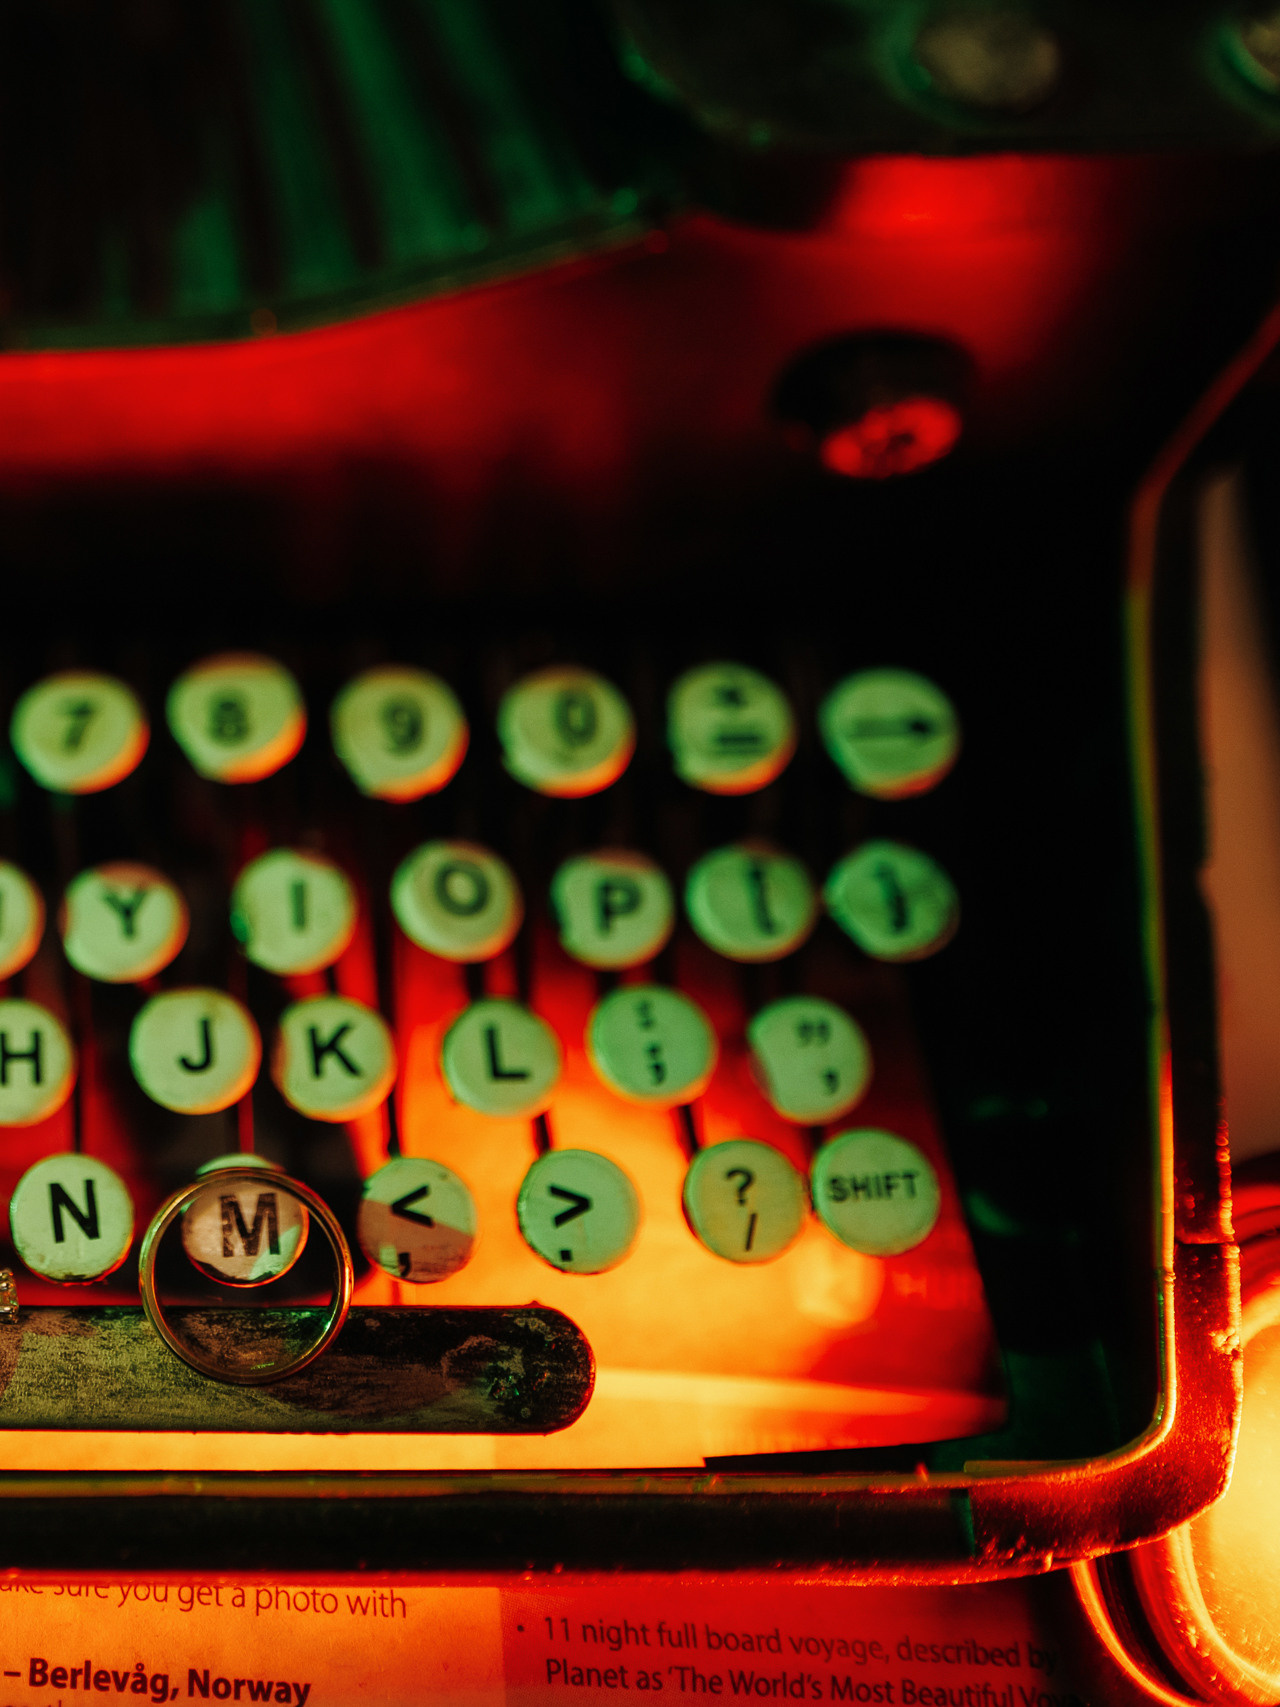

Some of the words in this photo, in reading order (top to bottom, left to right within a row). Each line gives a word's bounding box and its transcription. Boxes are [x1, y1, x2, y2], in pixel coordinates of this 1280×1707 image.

[60, 701, 97, 755] 7
[209, 696, 250, 749] 8
[380, 695, 426, 755] 9
[104, 884, 152, 939] Y
[433, 860, 491, 918] O
[595, 874, 643, 938] P
[176, 1016, 213, 1074] J
[308, 1020, 363, 1080] K
[484, 1025, 531, 1082] L
[47, 1177, 101, 1245] N
[827, 1168, 922, 1204] SHIFT
[218, 1190, 284, 1259] M
[118, 1583, 168, 1608] you
[178, 1584, 225, 1611] get
[231, 1588, 246, 1608] a
[255, 1585, 339, 1616] photo
[346, 1589, 408, 1618] with
[545, 1616, 570, 1642] 11
[582, 1619, 651, 1651] night
[657, 1621, 699, 1650] full
[705, 1622, 783, 1655] board
[787, 1635, 890, 1666] voyage,
[896, 1634, 1021, 1669] described
[1027, 1640, 1059, 1677] by
[28, 1657, 179, 1703] Berlevåg,
[187, 1668, 312, 1707] Norway
[546, 1657, 629, 1690] Planet
[636, 1669, 664, 1692] as
[728, 1668, 824, 1701] World's
[830, 1675, 896, 1705] Most
[901, 1677, 1014, 1707] Beautiful
